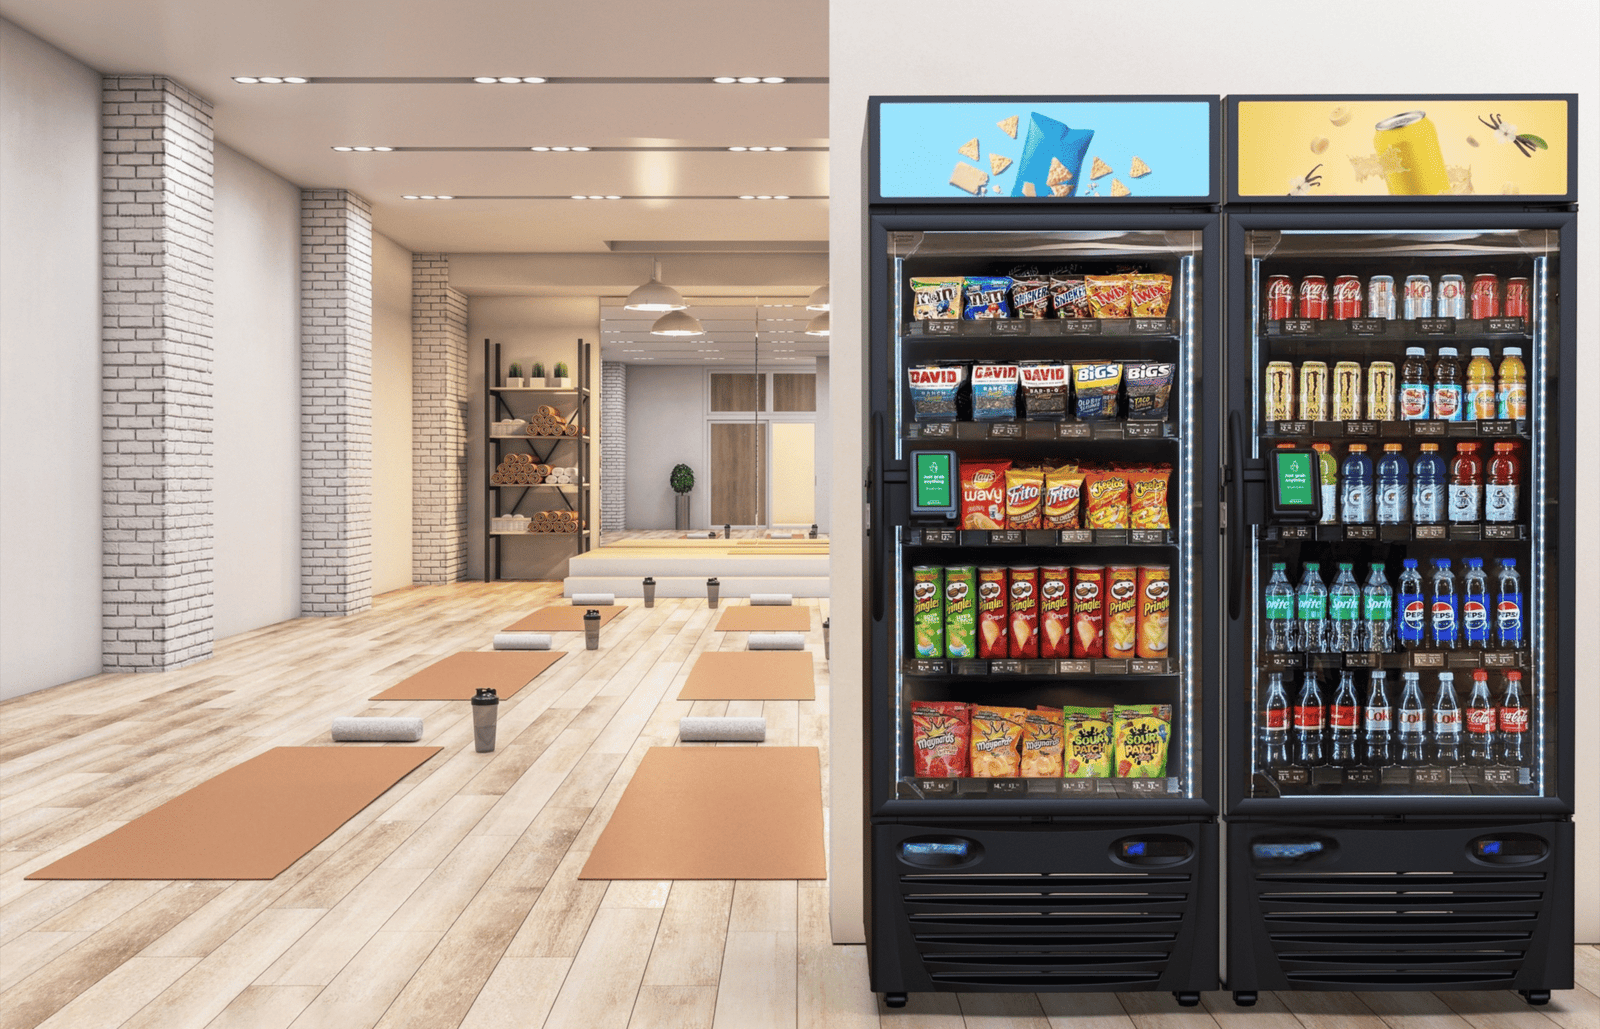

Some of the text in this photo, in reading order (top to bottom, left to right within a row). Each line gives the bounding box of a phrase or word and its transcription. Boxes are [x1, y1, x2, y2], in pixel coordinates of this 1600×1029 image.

[910, 370, 957, 384] DAVID
[974, 366, 1017, 379] DAVID
[1023, 368, 1065, 381] DAVID
[1134, 396, 1150, 404] TACO
[964, 488, 1003, 504] wavy
[1007, 484, 1039, 506] Frito
[1042, 597, 1068, 613] Pringles
[1074, 597, 1101, 613] Pringles
[1266, 598, 1289, 610] prite
[1298, 598, 1321, 610] prite
[1332, 598, 1358, 611] Sprit
[1366, 598, 1392, 611] Sprit
[1074, 734, 1105, 746] SOUR
[1126, 733, 1158, 746] SOUR
[1073, 744, 1106, 757] PATCH
[1125, 743, 1159, 757] PATCH
